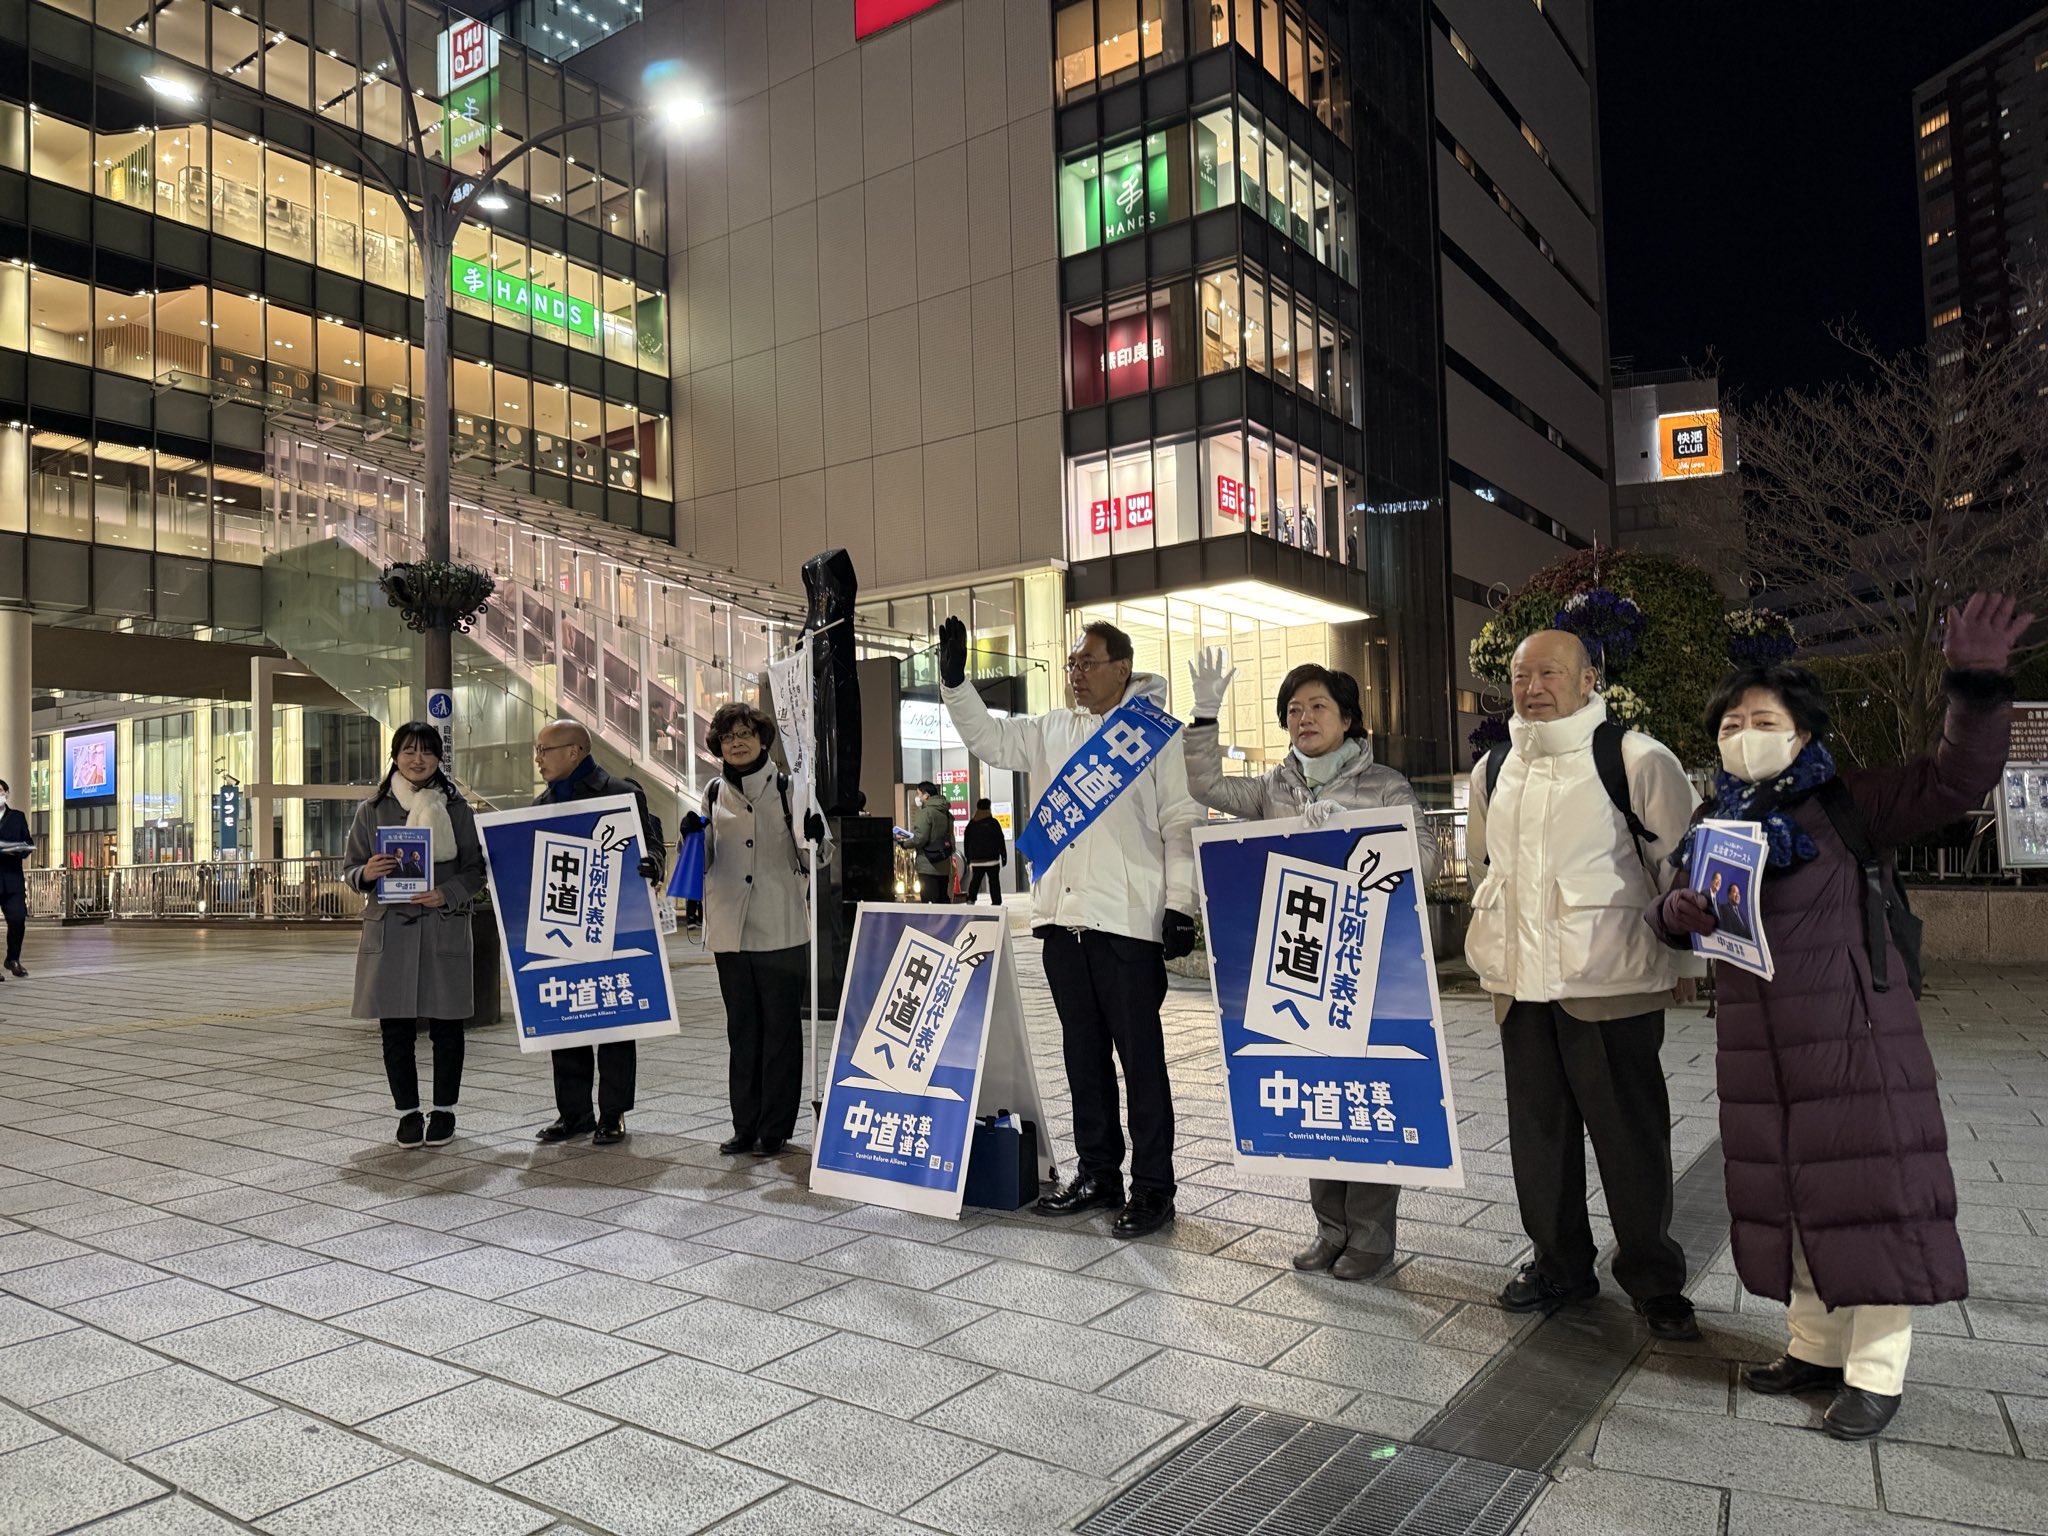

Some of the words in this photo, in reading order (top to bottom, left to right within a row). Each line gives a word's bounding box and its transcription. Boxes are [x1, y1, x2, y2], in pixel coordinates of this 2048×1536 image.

[1105, 210, 1157, 238] HANDS
[497, 279, 582, 325] HANDS
[1677, 430, 1703, 444] 快活
[1678, 443, 1703, 454] CLUB
[1222, 479, 1235, 495] ユニ
[1128, 495, 1150, 510] UNI
[1222, 494, 1236, 510] クロ
[1128, 510, 1152, 526] QLO
[586, 848, 610, 944] 比例代表は
[1328, 885, 1370, 1031] 比例代表は
[907, 957, 961, 1073] 比例代表は
[1288, 1131, 1314, 1140] Centrist
[1315, 1133, 1339, 1142] Reform
[1340, 1134, 1369, 1144] Alliance
